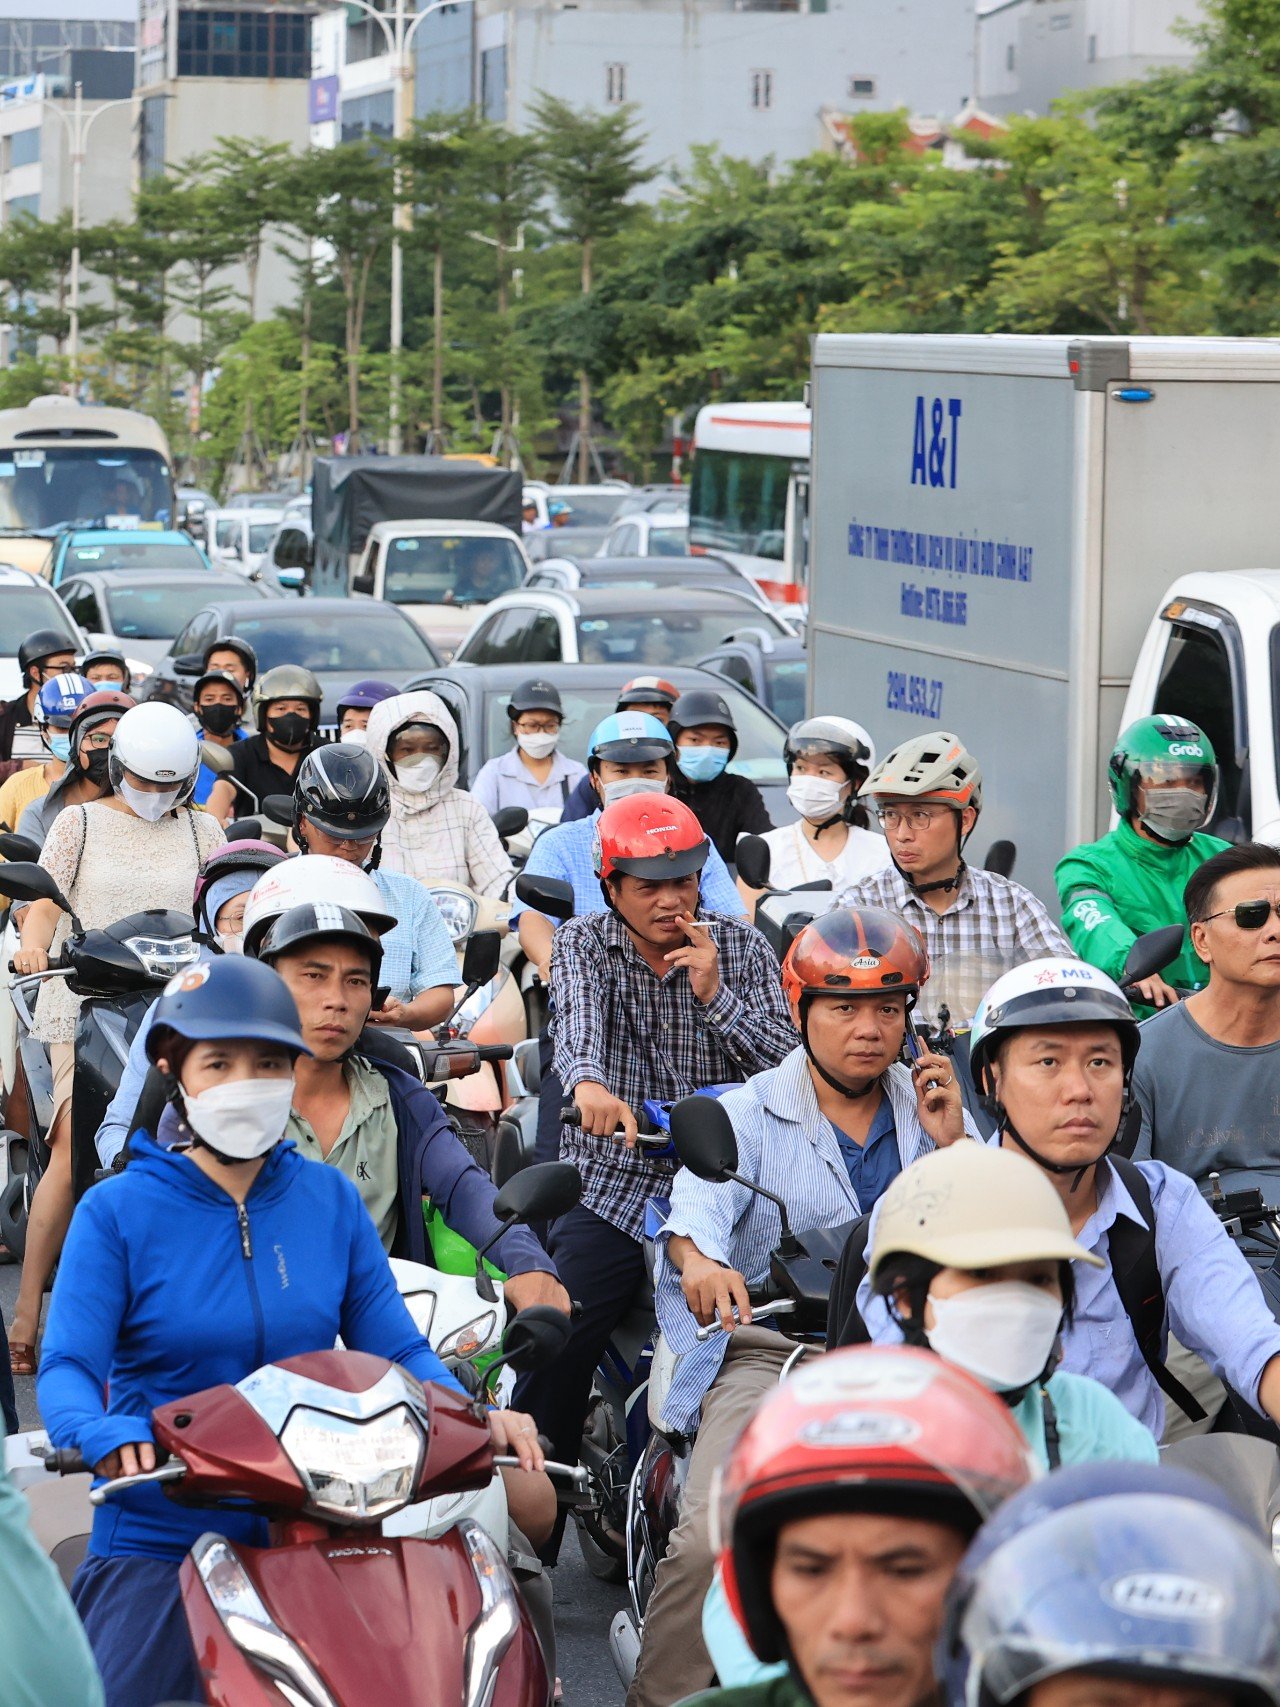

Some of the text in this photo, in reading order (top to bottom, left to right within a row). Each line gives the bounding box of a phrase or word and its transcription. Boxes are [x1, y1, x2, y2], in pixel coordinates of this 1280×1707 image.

[911, 396, 961, 489] A&T
[1168, 743, 1204, 758] Grab
[645, 825, 678, 835] HONDA
[854, 958, 879, 967] Asia
[1062, 968, 1093, 979] MB
